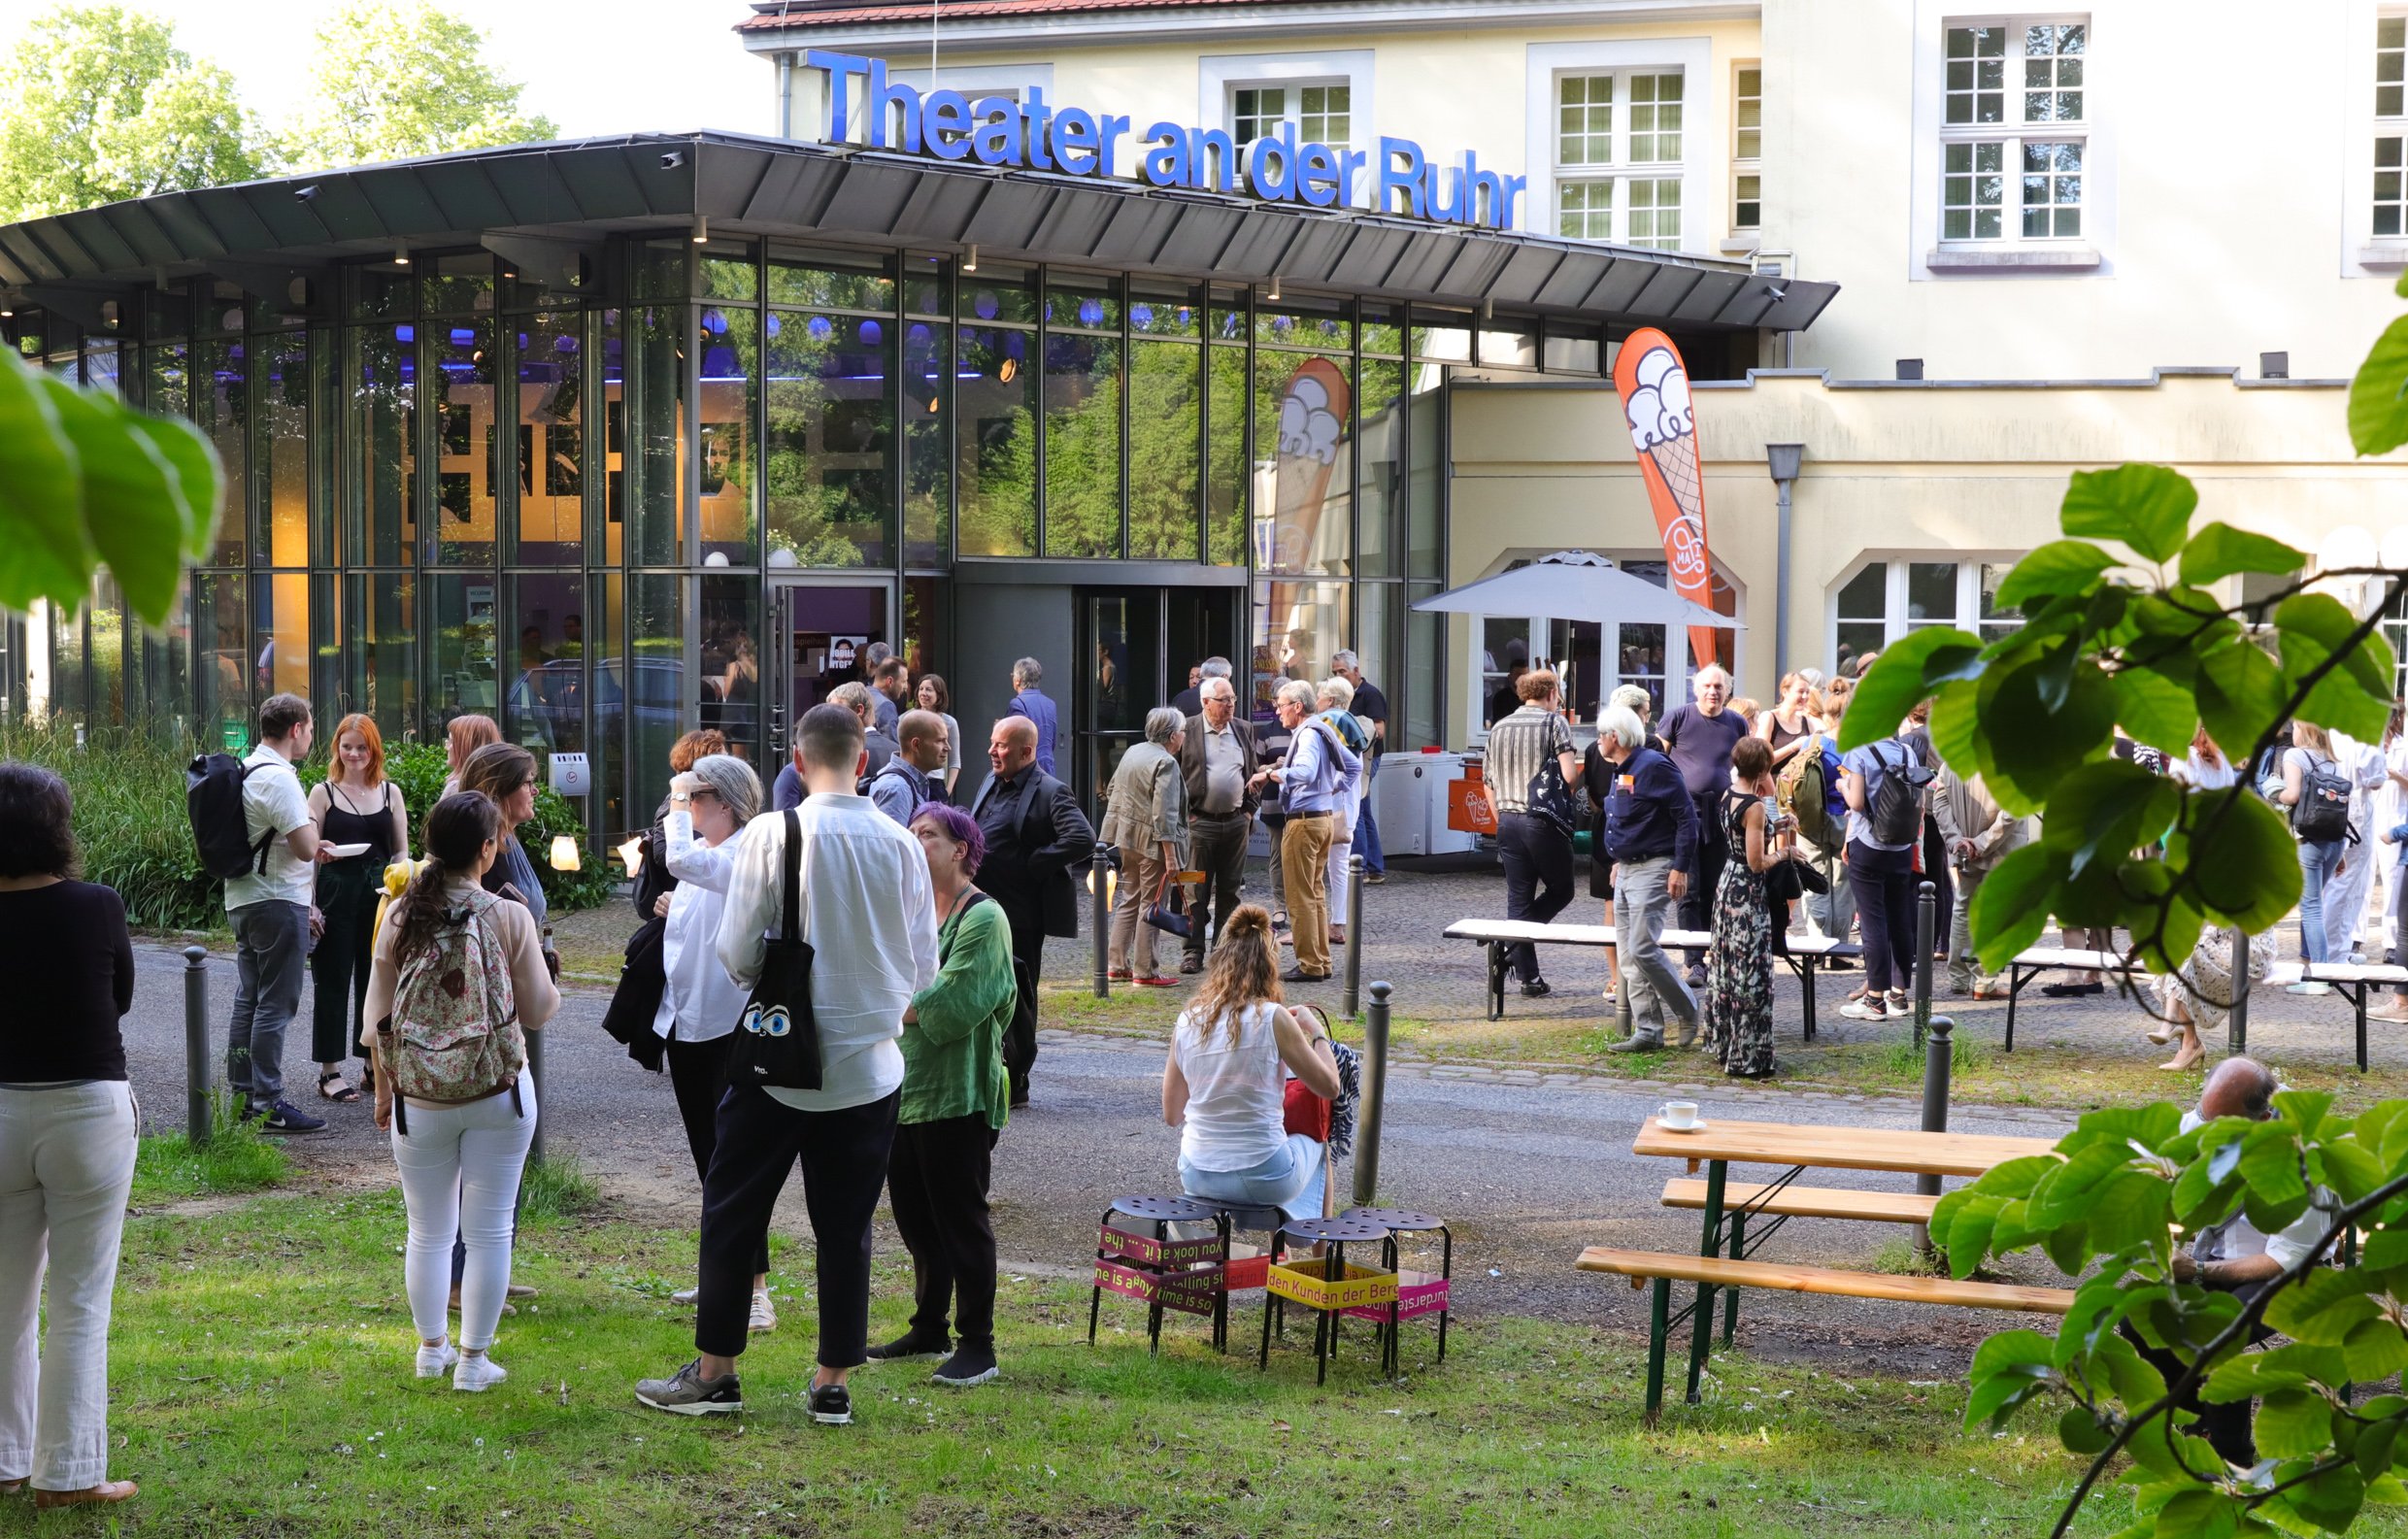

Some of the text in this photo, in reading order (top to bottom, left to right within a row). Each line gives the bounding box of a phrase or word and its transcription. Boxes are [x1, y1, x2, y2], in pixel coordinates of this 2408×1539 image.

[802, 49, 1528, 230] Theater an der Ruhr
[1105, 1232, 1124, 1250] the
[1202, 1239, 1222, 1255] you
[1156, 1246, 1170, 1261] at
[1173, 1246, 1198, 1262] look
[1112, 1269, 1122, 1286] is
[1268, 1273, 1288, 1290] den
[1292, 1279, 1338, 1304] Kunden
[1342, 1288, 1365, 1302] der
[1156, 1286, 1183, 1304] time
[1186, 1291, 1195, 1307] is
[1197, 1298, 1212, 1311] so
